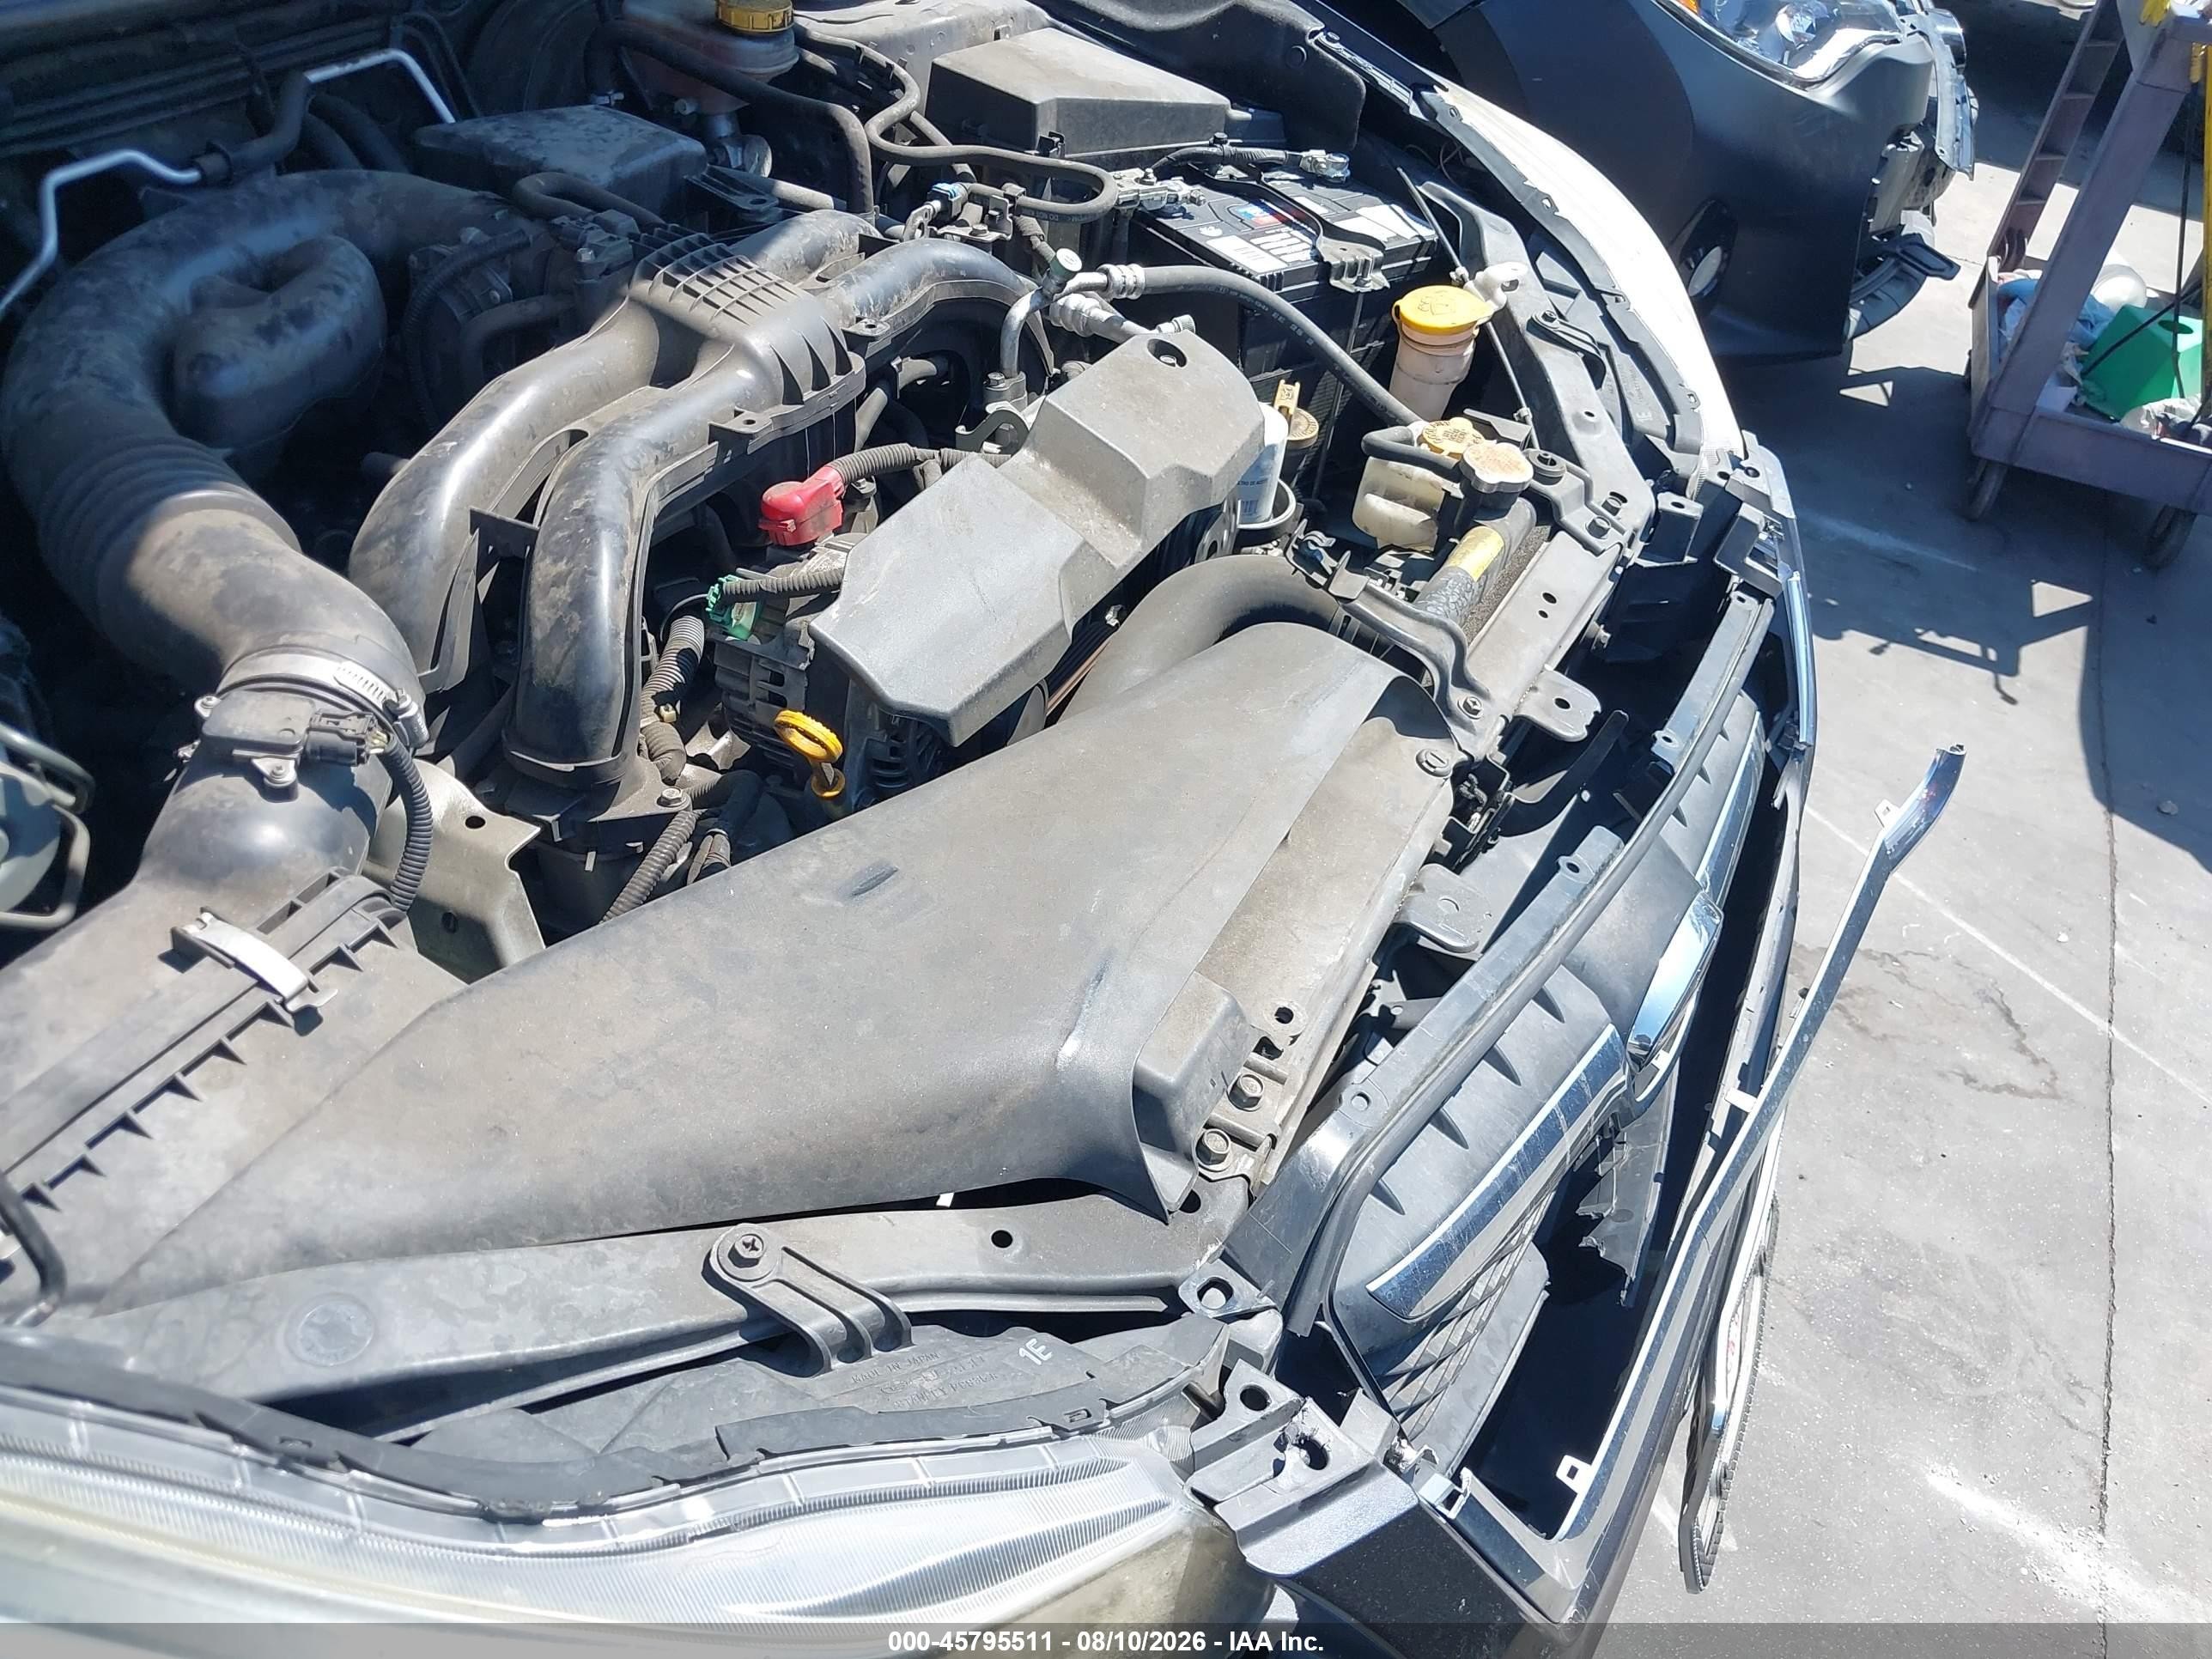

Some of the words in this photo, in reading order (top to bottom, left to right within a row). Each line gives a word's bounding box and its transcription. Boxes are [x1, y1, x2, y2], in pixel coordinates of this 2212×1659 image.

[887, 1361, 902, 1374] IN
[906, 1352, 942, 1368] JAPAN
[1018, 1338, 1053, 1366] 1E
